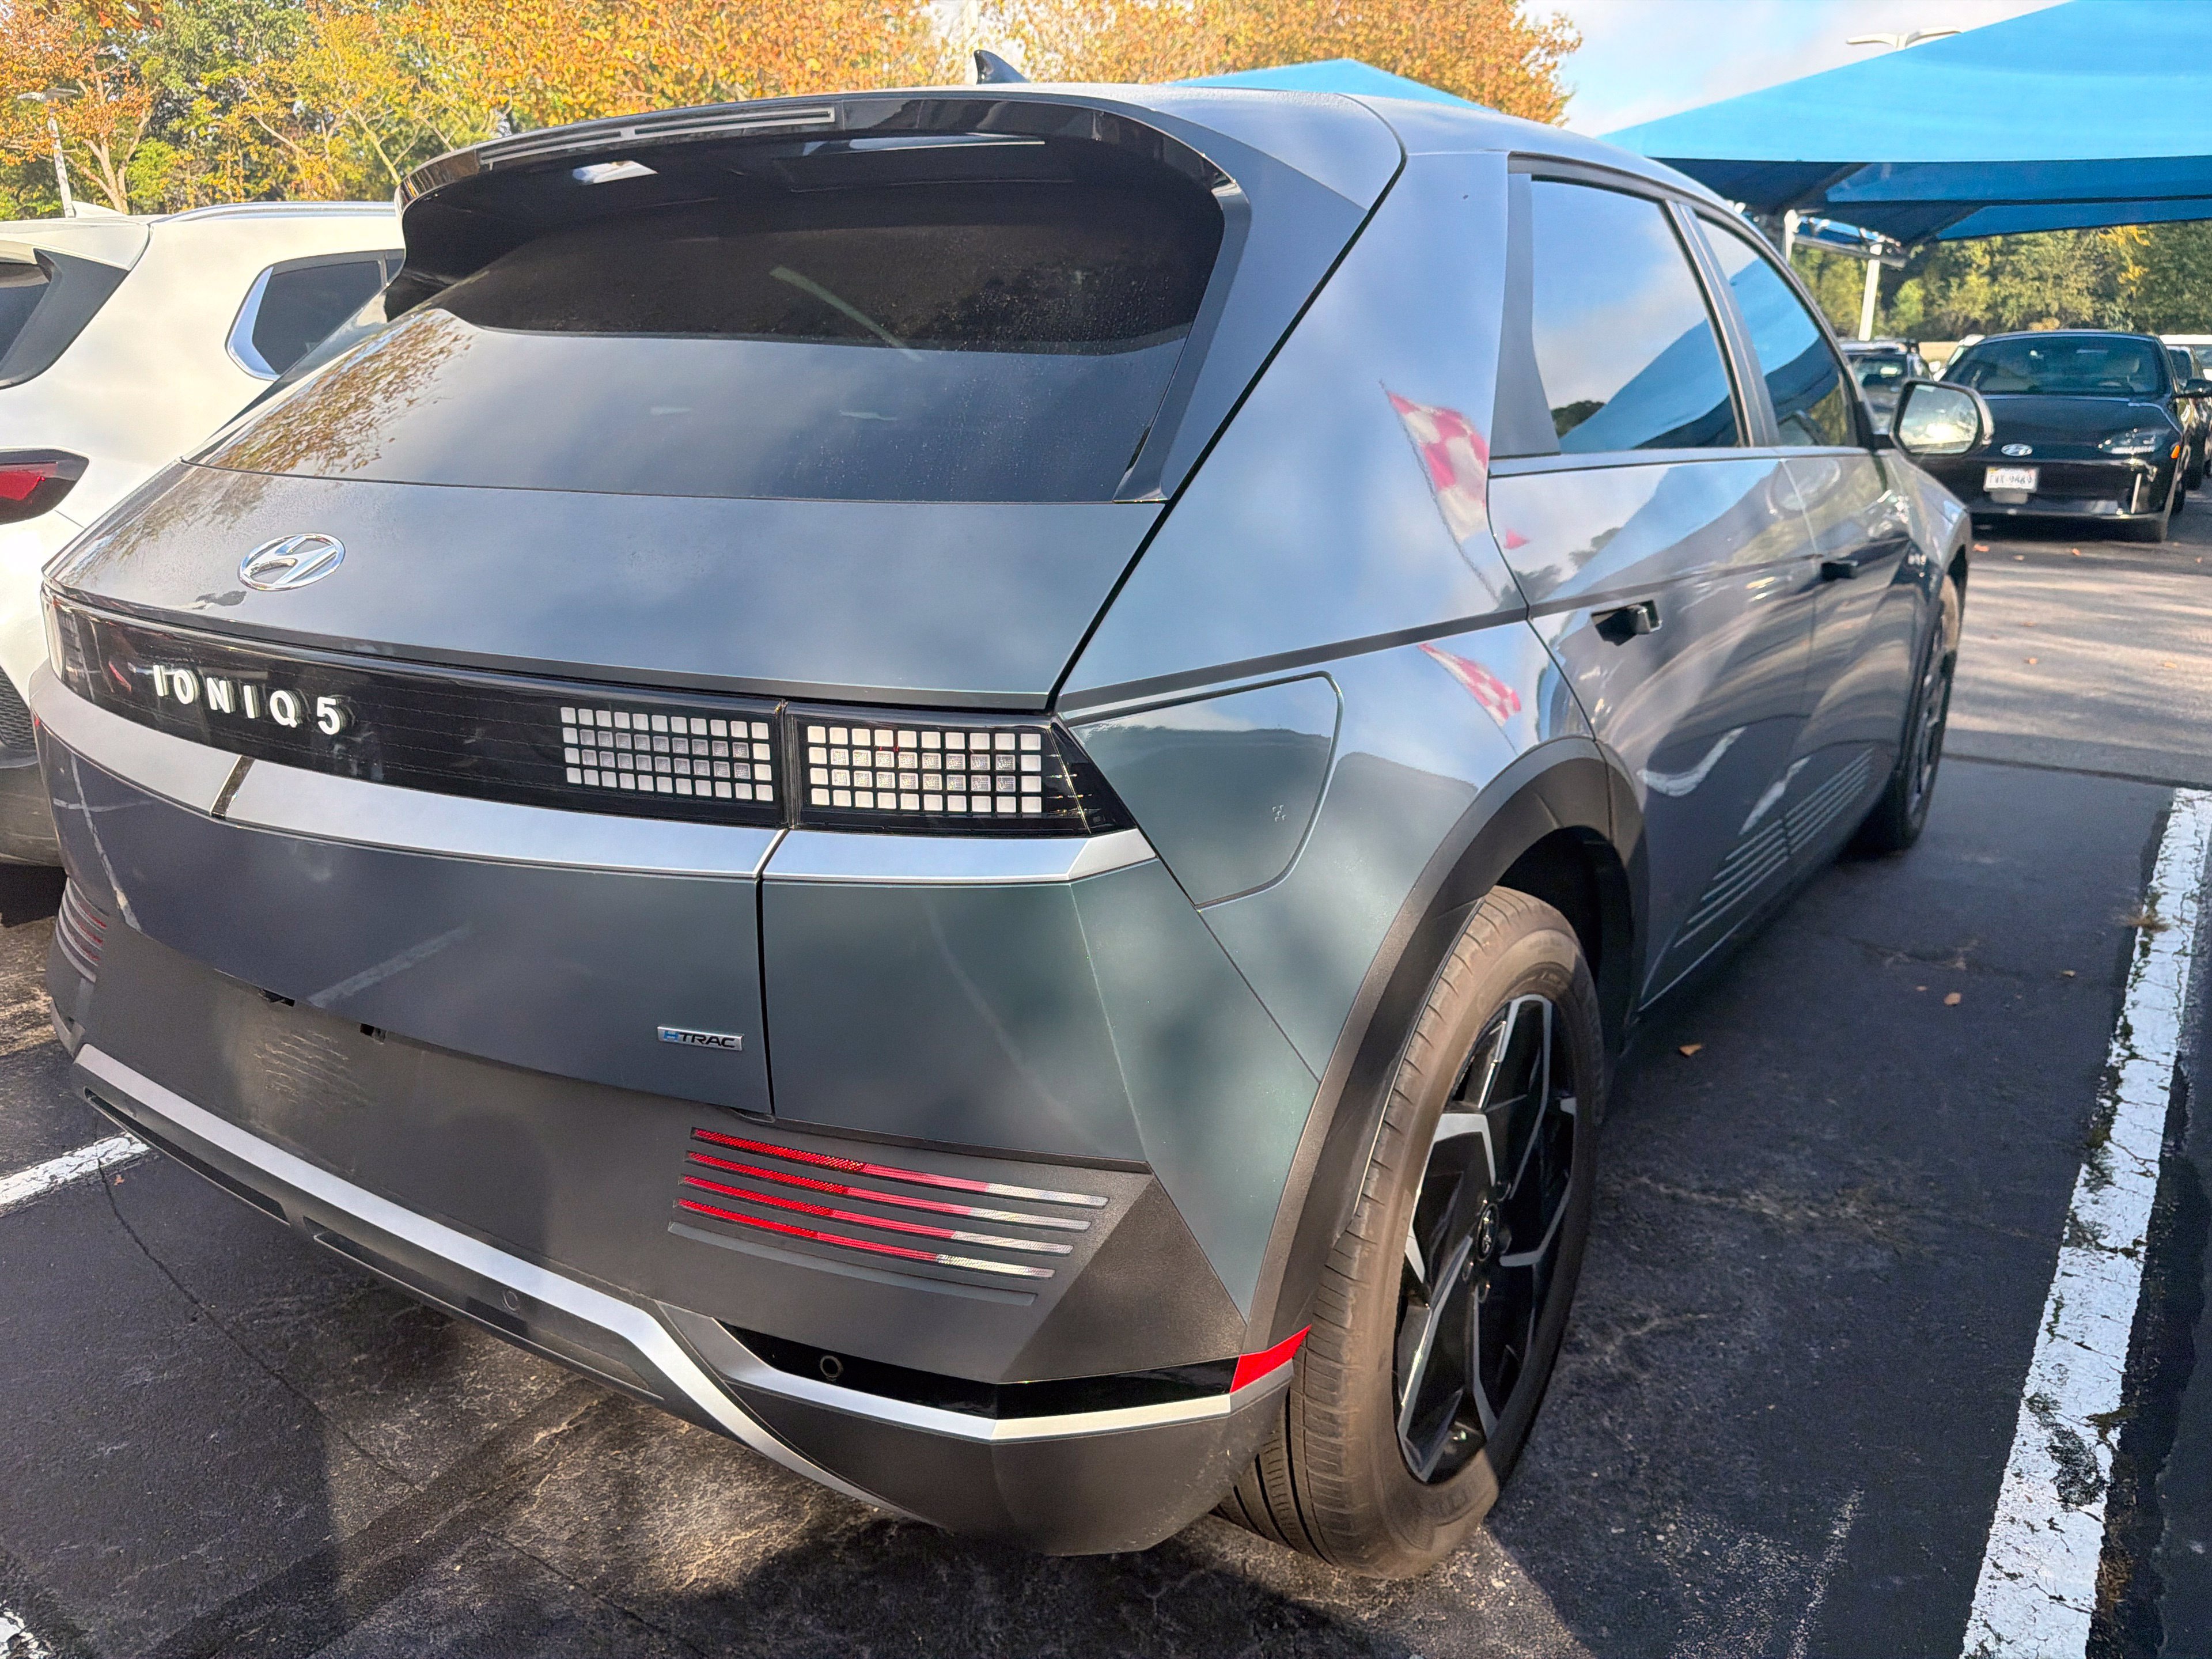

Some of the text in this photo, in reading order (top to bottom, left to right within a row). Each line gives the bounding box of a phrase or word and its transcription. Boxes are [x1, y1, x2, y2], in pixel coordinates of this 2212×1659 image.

[153, 664, 343, 735] IONIQ 5
[663, 1031, 736, 1048] HTRAC
